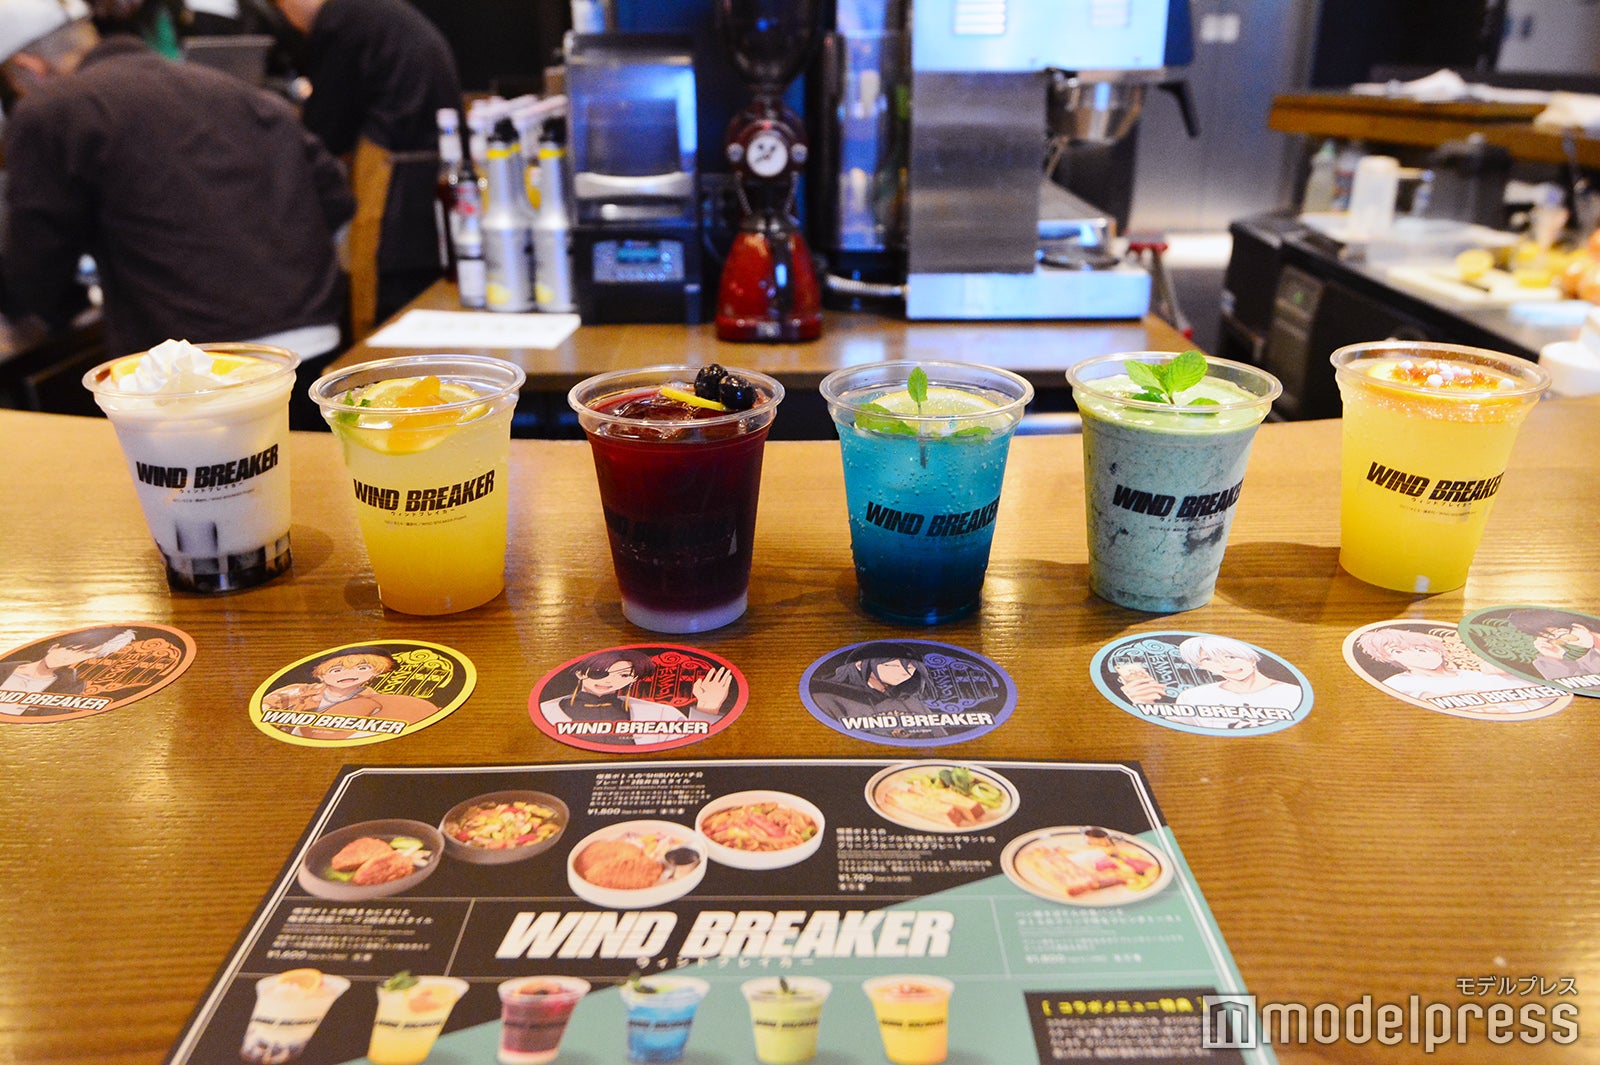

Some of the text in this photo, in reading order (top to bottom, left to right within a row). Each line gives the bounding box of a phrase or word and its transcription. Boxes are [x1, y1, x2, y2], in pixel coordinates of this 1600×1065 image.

[136, 443, 279, 489] WIND BREAKER
[1366, 461, 1431, 498] WIND
[353, 469, 495, 512] WIND BREAKER
[1112, 484, 1176, 517] WIND
[865, 500, 925, 536] WIND
[20, 693, 110, 711] BREAKER
[1138, 704, 1293, 721] WIND BREAKER
[1429, 694, 1486, 709] WIND
[261, 710, 405, 734] WIND BREAKER
[556, 721, 709, 735] WIND BREAKER
[841, 712, 994, 730] WIND BREAKER
[494, 909, 956, 960] WIND BREAKER
